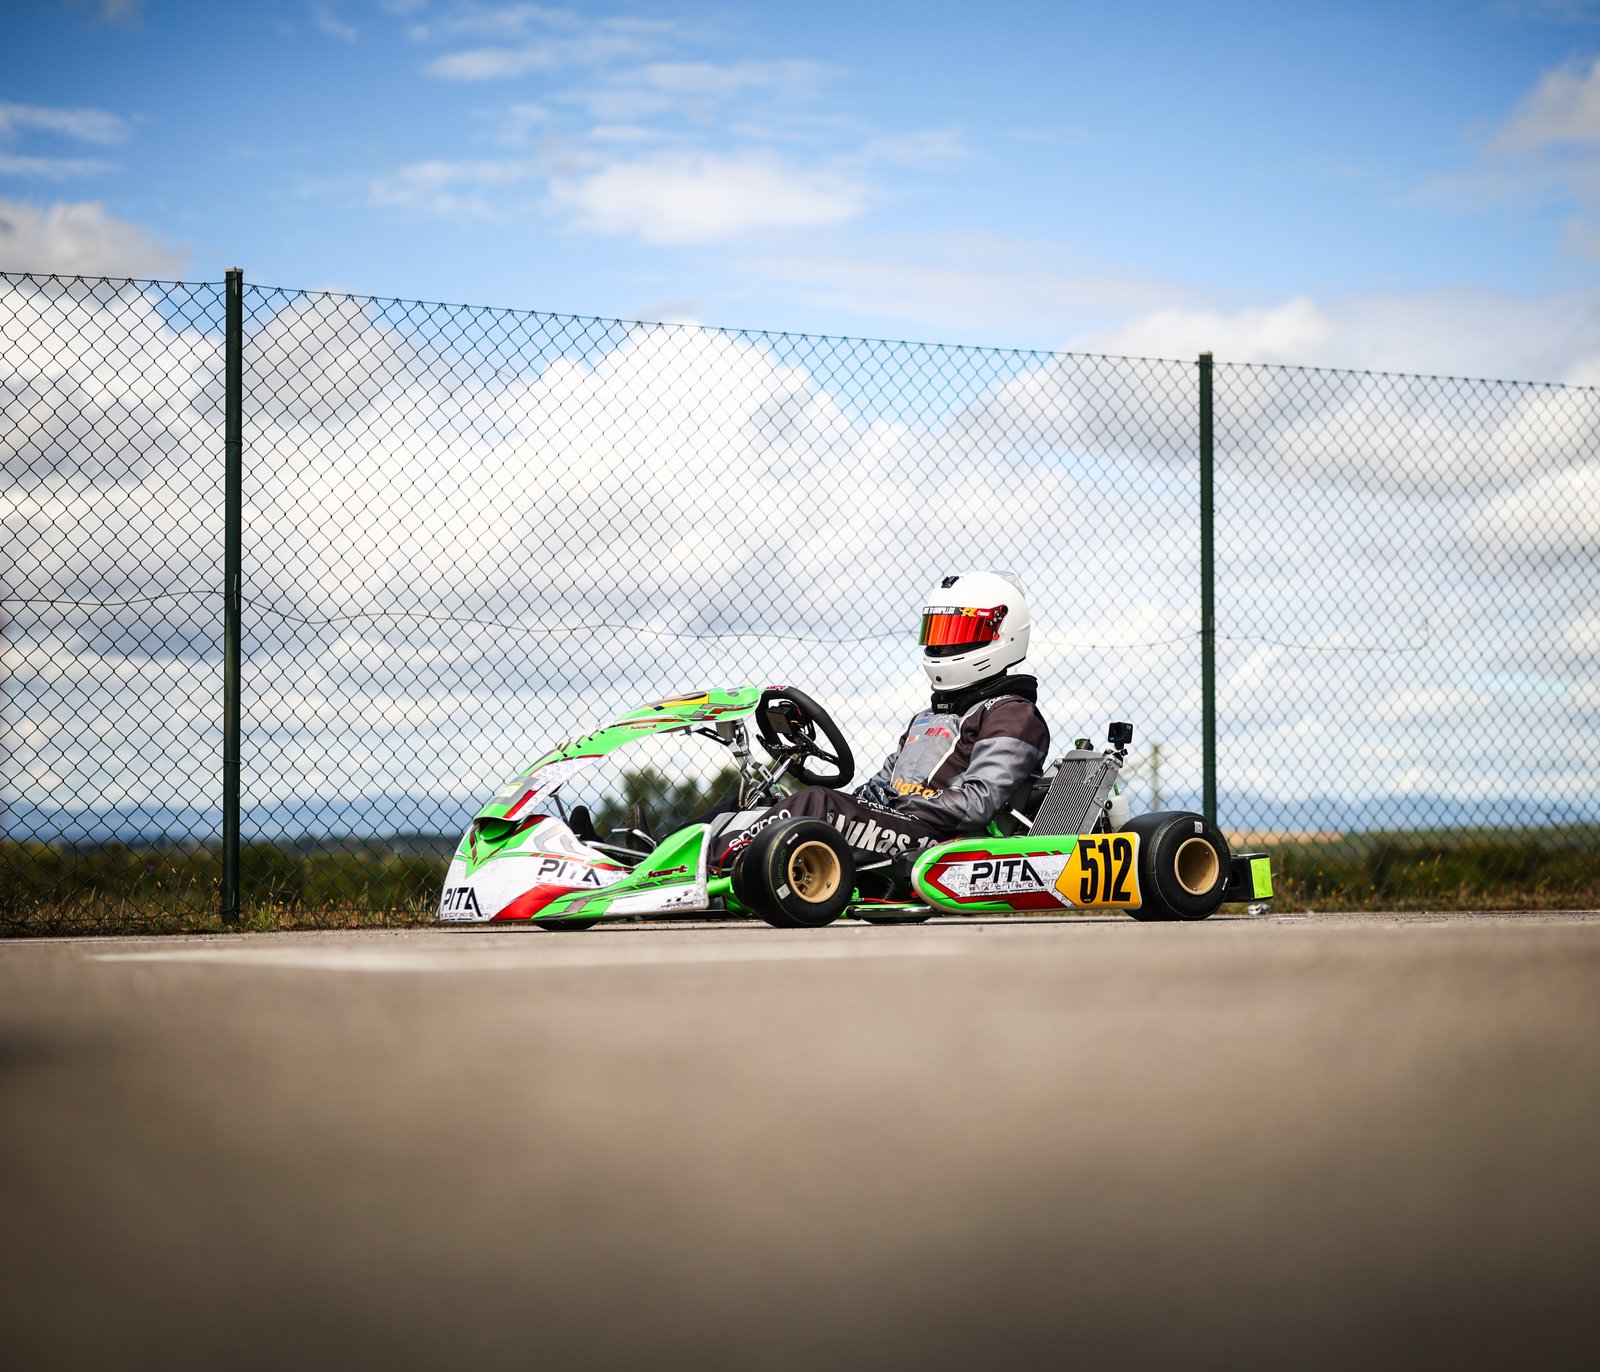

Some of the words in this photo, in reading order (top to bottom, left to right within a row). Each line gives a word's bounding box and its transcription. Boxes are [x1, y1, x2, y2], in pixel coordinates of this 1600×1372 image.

[537, 858, 601, 886] PITA
[969, 859, 1045, 887] PITA
[1078, 837, 1133, 904] 512
[969, 881, 1034, 892] RACING
[441, 886, 483, 918] PITA
